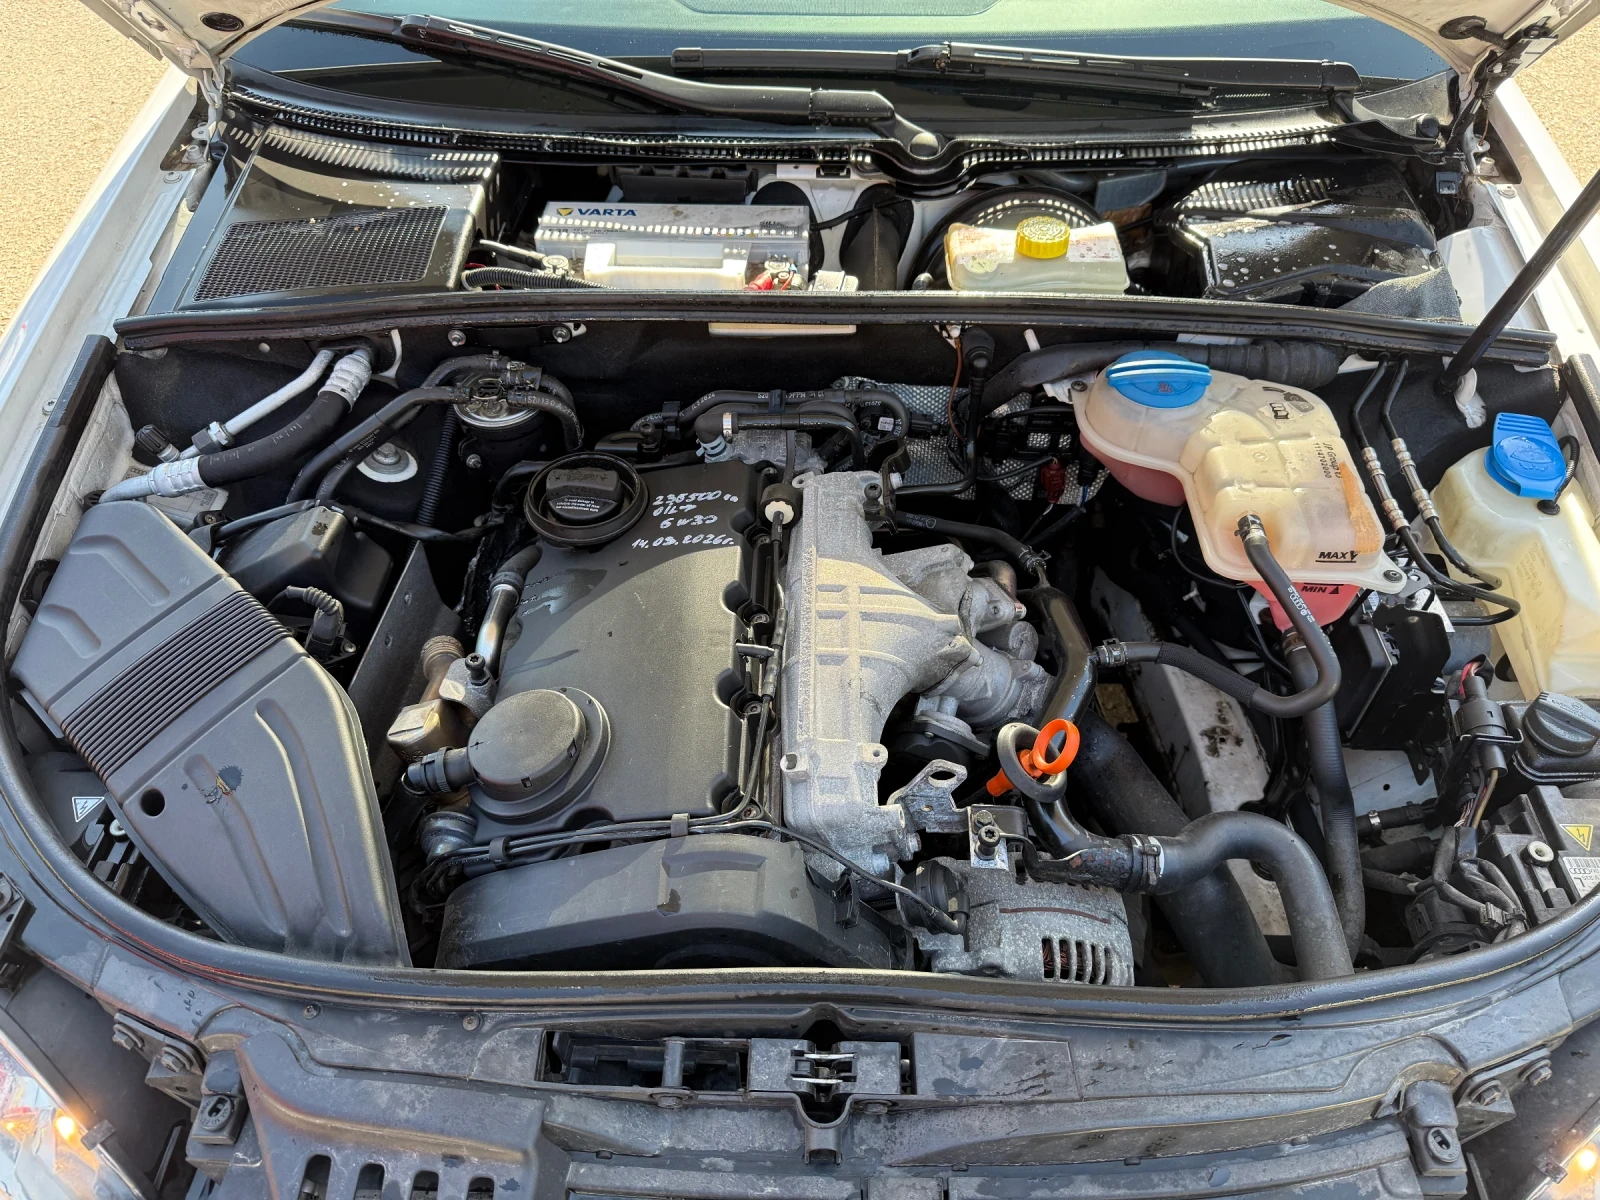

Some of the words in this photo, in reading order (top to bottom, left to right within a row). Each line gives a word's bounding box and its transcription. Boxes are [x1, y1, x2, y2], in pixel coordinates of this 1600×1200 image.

[577, 208, 637, 217] VARTA
[1318, 551, 1349, 560] MAX
[1301, 585, 1328, 593] MIN
